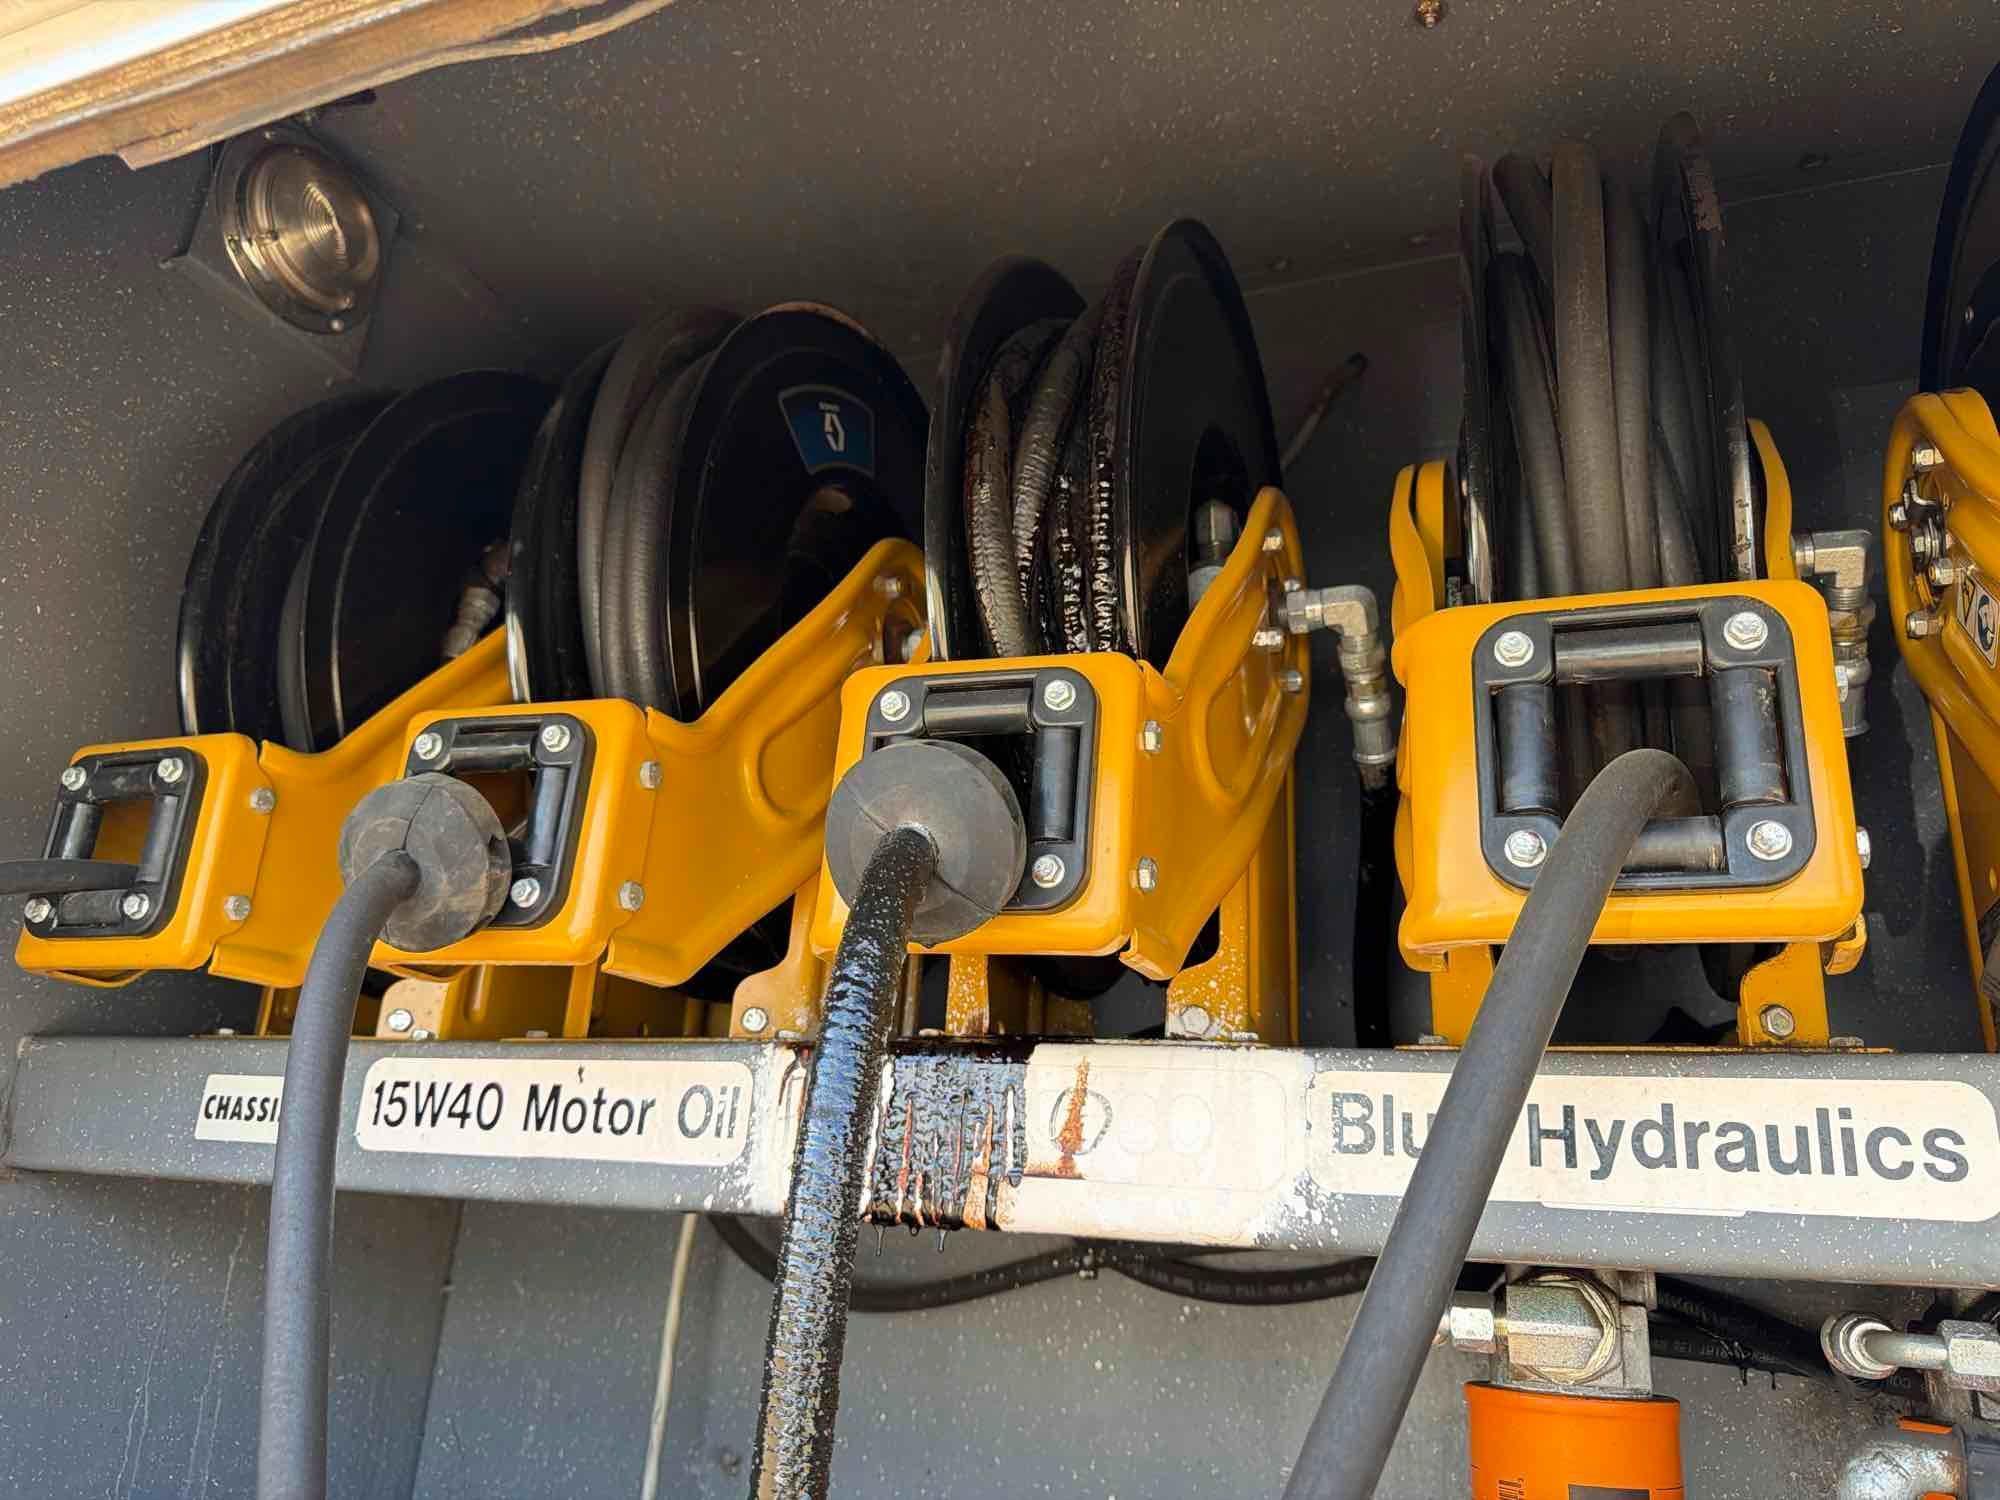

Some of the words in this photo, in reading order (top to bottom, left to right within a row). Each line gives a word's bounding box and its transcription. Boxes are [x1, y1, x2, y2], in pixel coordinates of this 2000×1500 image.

[203, 1094, 280, 1122] CHASSI
[373, 1081, 504, 1131] 15W40
[522, 1084, 657, 1136] Motor
[677, 1084, 743, 1139] Oil
[1331, 1092, 1435, 1159] Blu
[1527, 1102, 1970, 1182] Hydraulics
